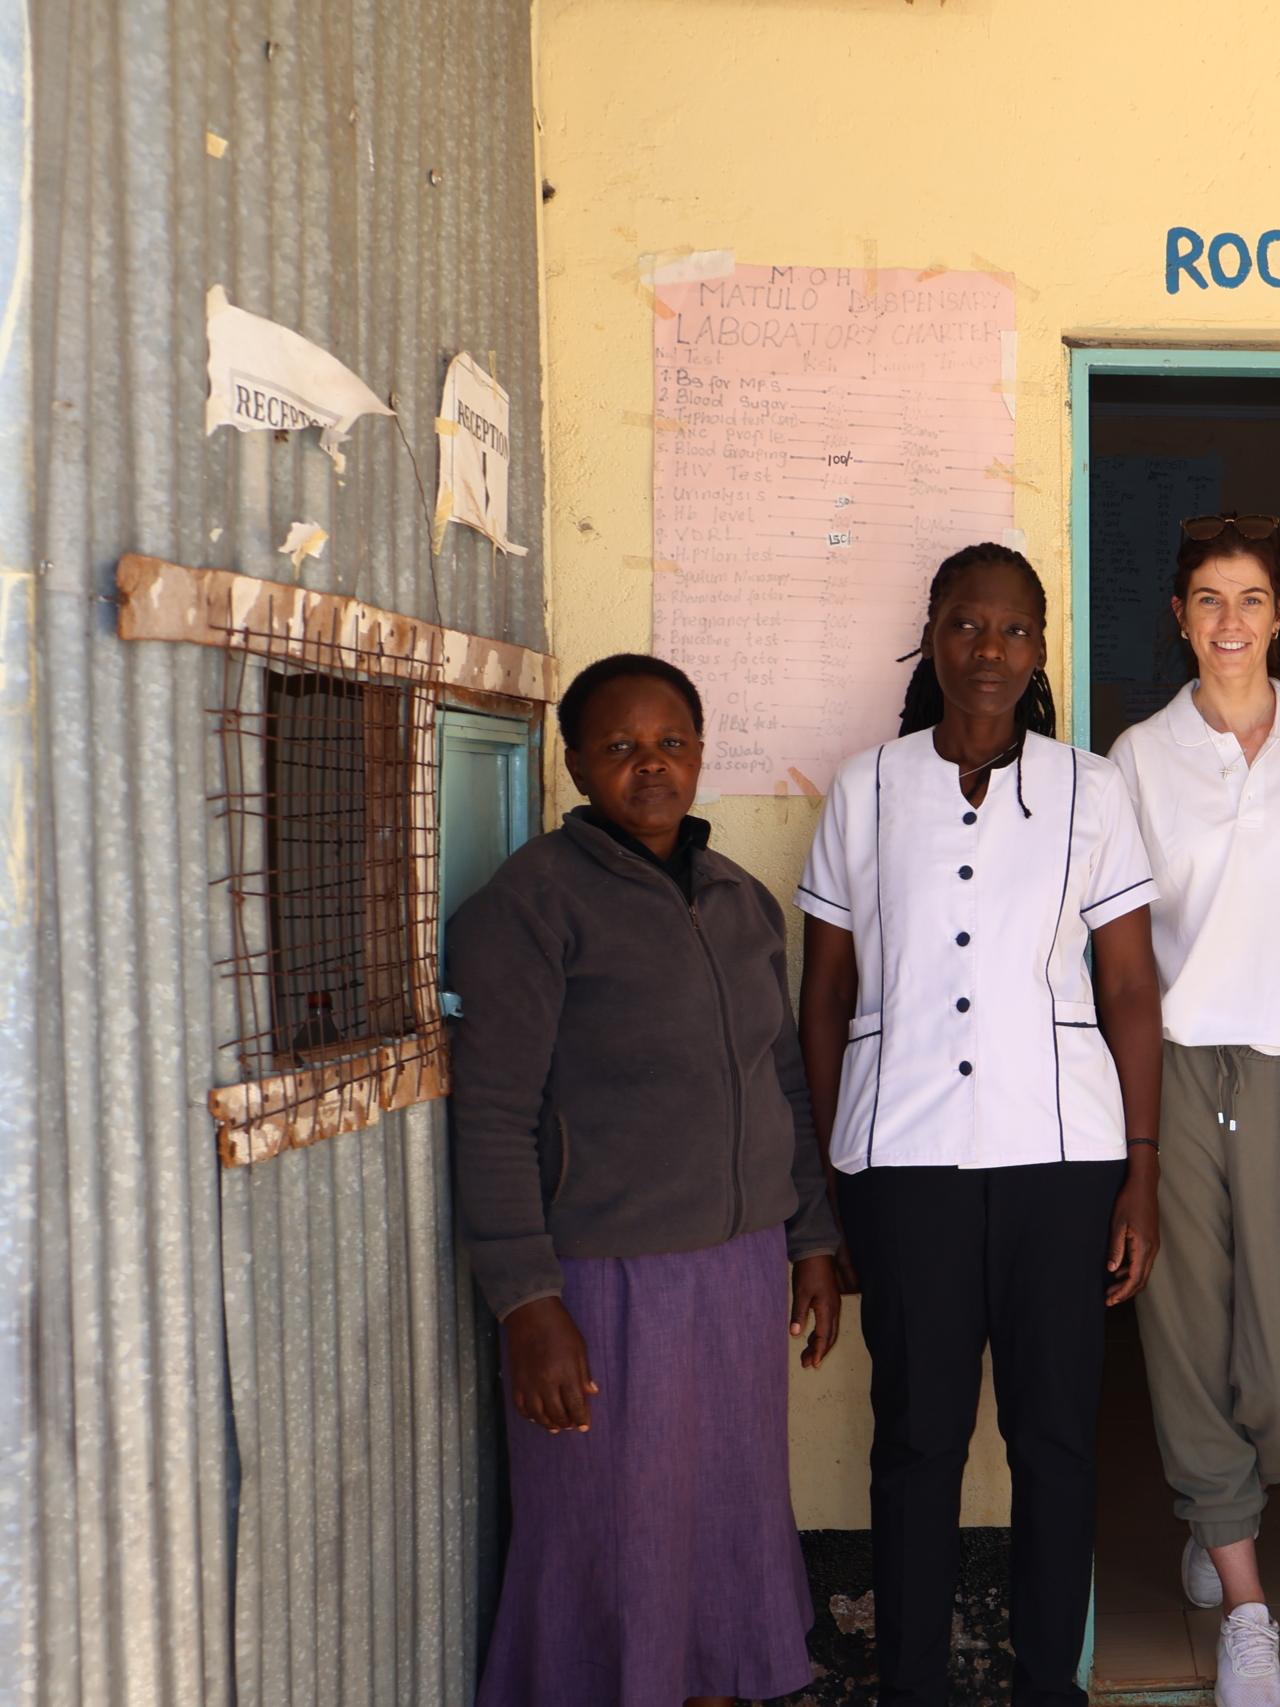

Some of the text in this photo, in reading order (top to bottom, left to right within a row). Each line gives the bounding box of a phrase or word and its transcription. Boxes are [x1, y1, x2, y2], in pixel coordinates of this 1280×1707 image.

[675, 313, 1002, 351] LABORATORY CHARTER
[708, 375, 731, 394] for
[236, 384, 333, 429] RECEPT
[675, 387, 724, 408] Blood
[739, 394, 789, 418] Sugar
[674, 440, 717, 456] Blood
[674, 460, 772, 483] HIV Test
[674, 524, 743, 542] VDRL
